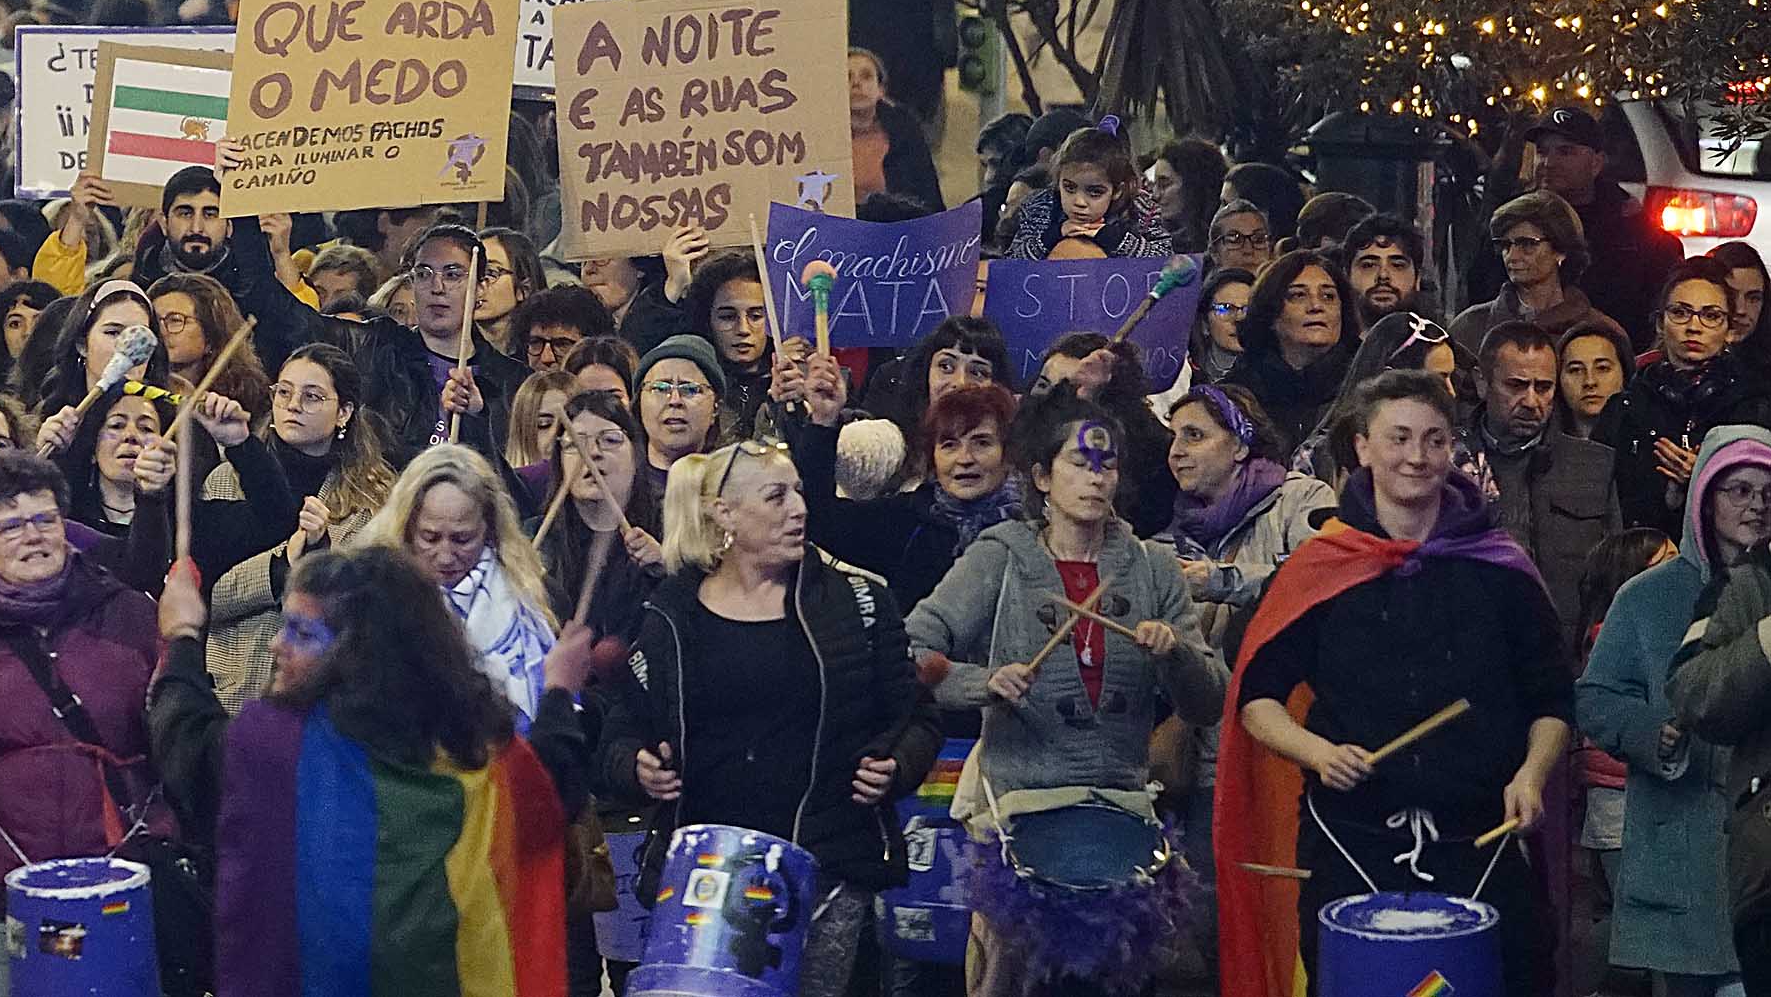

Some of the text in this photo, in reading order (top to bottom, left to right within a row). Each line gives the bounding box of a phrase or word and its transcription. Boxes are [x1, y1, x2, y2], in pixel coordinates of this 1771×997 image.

[254, 0, 366, 57] QUE
[577, 8, 781, 76] A NOITE
[249, 58, 468, 120] O MEDO
[568, 68, 798, 130] E AS RUAS
[238, 118, 445, 152] ACENDEMOS FACHOS
[294, 145, 375, 166] ILUMINAR
[385, 145, 401, 159] O
[578, 125, 807, 185] TAMBÉN SOM
[232, 168, 317, 190] CAMIÑO
[581, 183, 732, 233] NOSSAS
